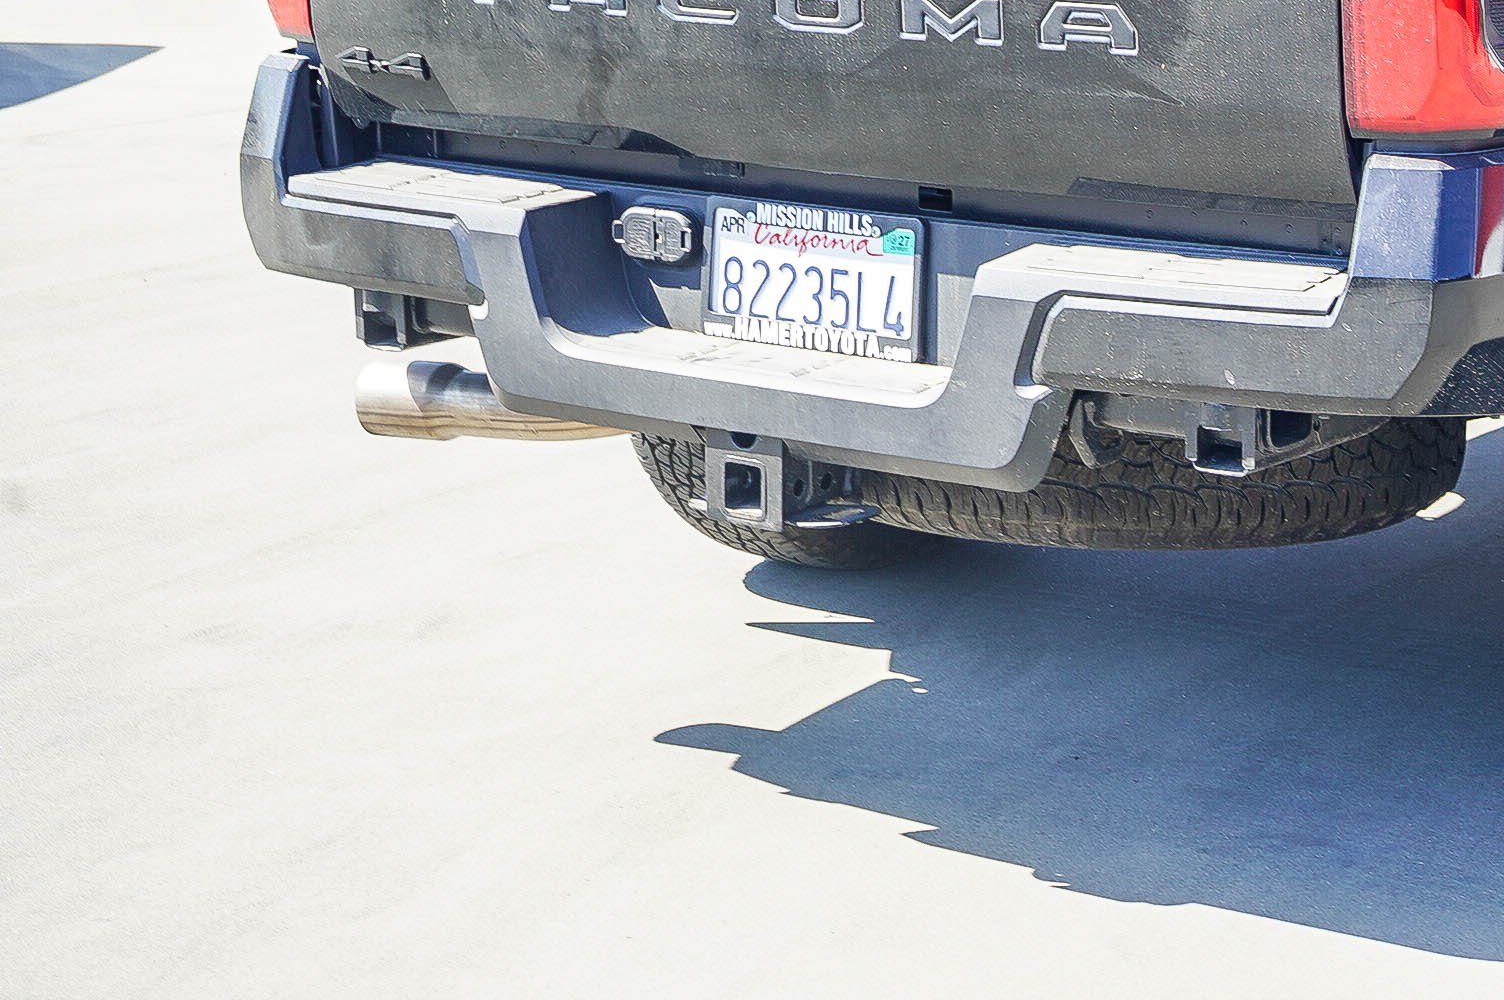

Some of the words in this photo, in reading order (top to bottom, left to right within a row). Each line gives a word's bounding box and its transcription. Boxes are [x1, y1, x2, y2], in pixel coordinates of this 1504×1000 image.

[721, 215, 745, 234] APR
[756, 203, 824, 231] MISSION
[827, 209, 873, 237] HILLS
[754, 222, 883, 257] California
[722, 256, 905, 336] 82235L4
